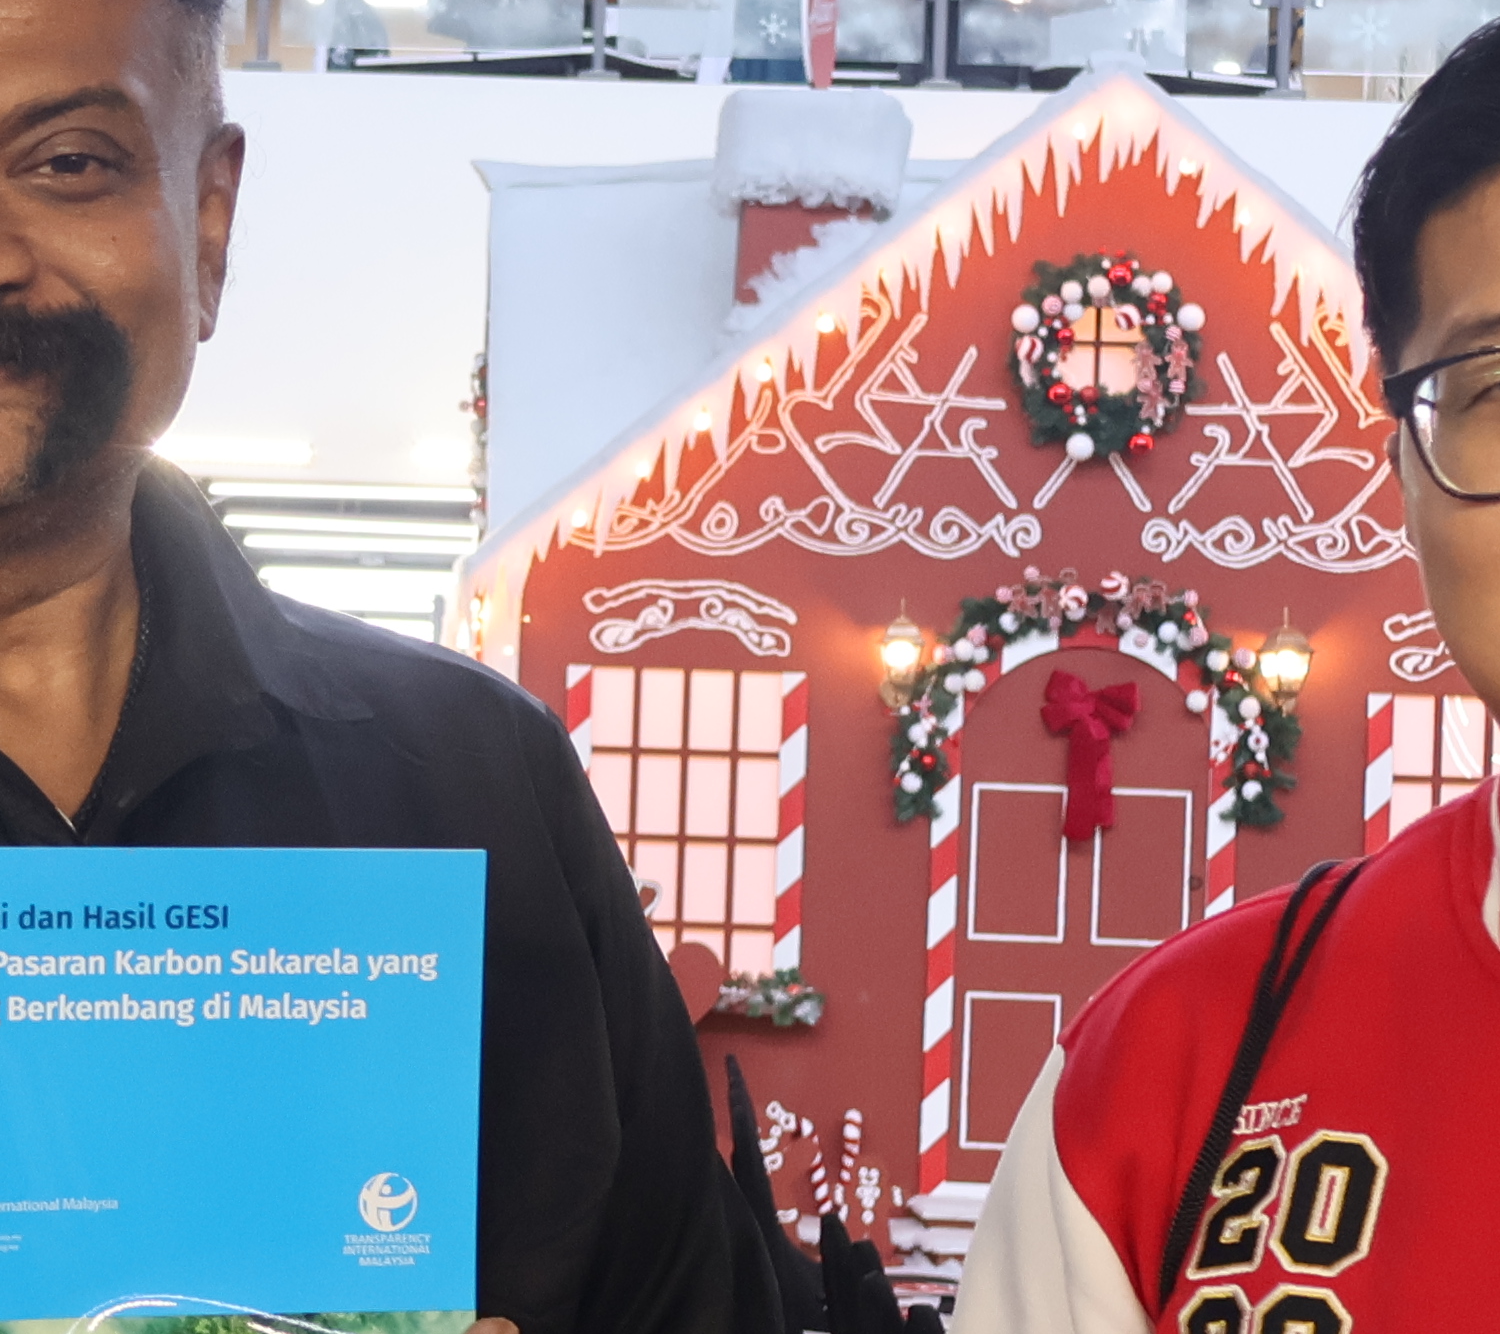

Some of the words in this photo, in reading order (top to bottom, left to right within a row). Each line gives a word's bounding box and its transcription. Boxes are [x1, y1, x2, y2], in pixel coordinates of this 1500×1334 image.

[19, 904, 72, 929] dan
[84, 902, 155, 929] Hasil
[165, 905, 228, 929] GESI
[115, 949, 223, 975] Karbon
[231, 948, 360, 974] Sukarela
[367, 954, 438, 981] yang
[8, 994, 196, 1026] Berkembang
[203, 992, 231, 1019] di
[239, 991, 368, 1025] Malaysia
[1233, 1094, 1308, 1135] SINCE
[62, 1197, 119, 1212] Malaysia
[1186, 1129, 1389, 1280] 20
[342, 1244, 430, 1255] INTERNATIONAL
[344, 1233, 431, 1244] TRANSPARENCY
[359, 1256, 416, 1267] MALAYSIA
